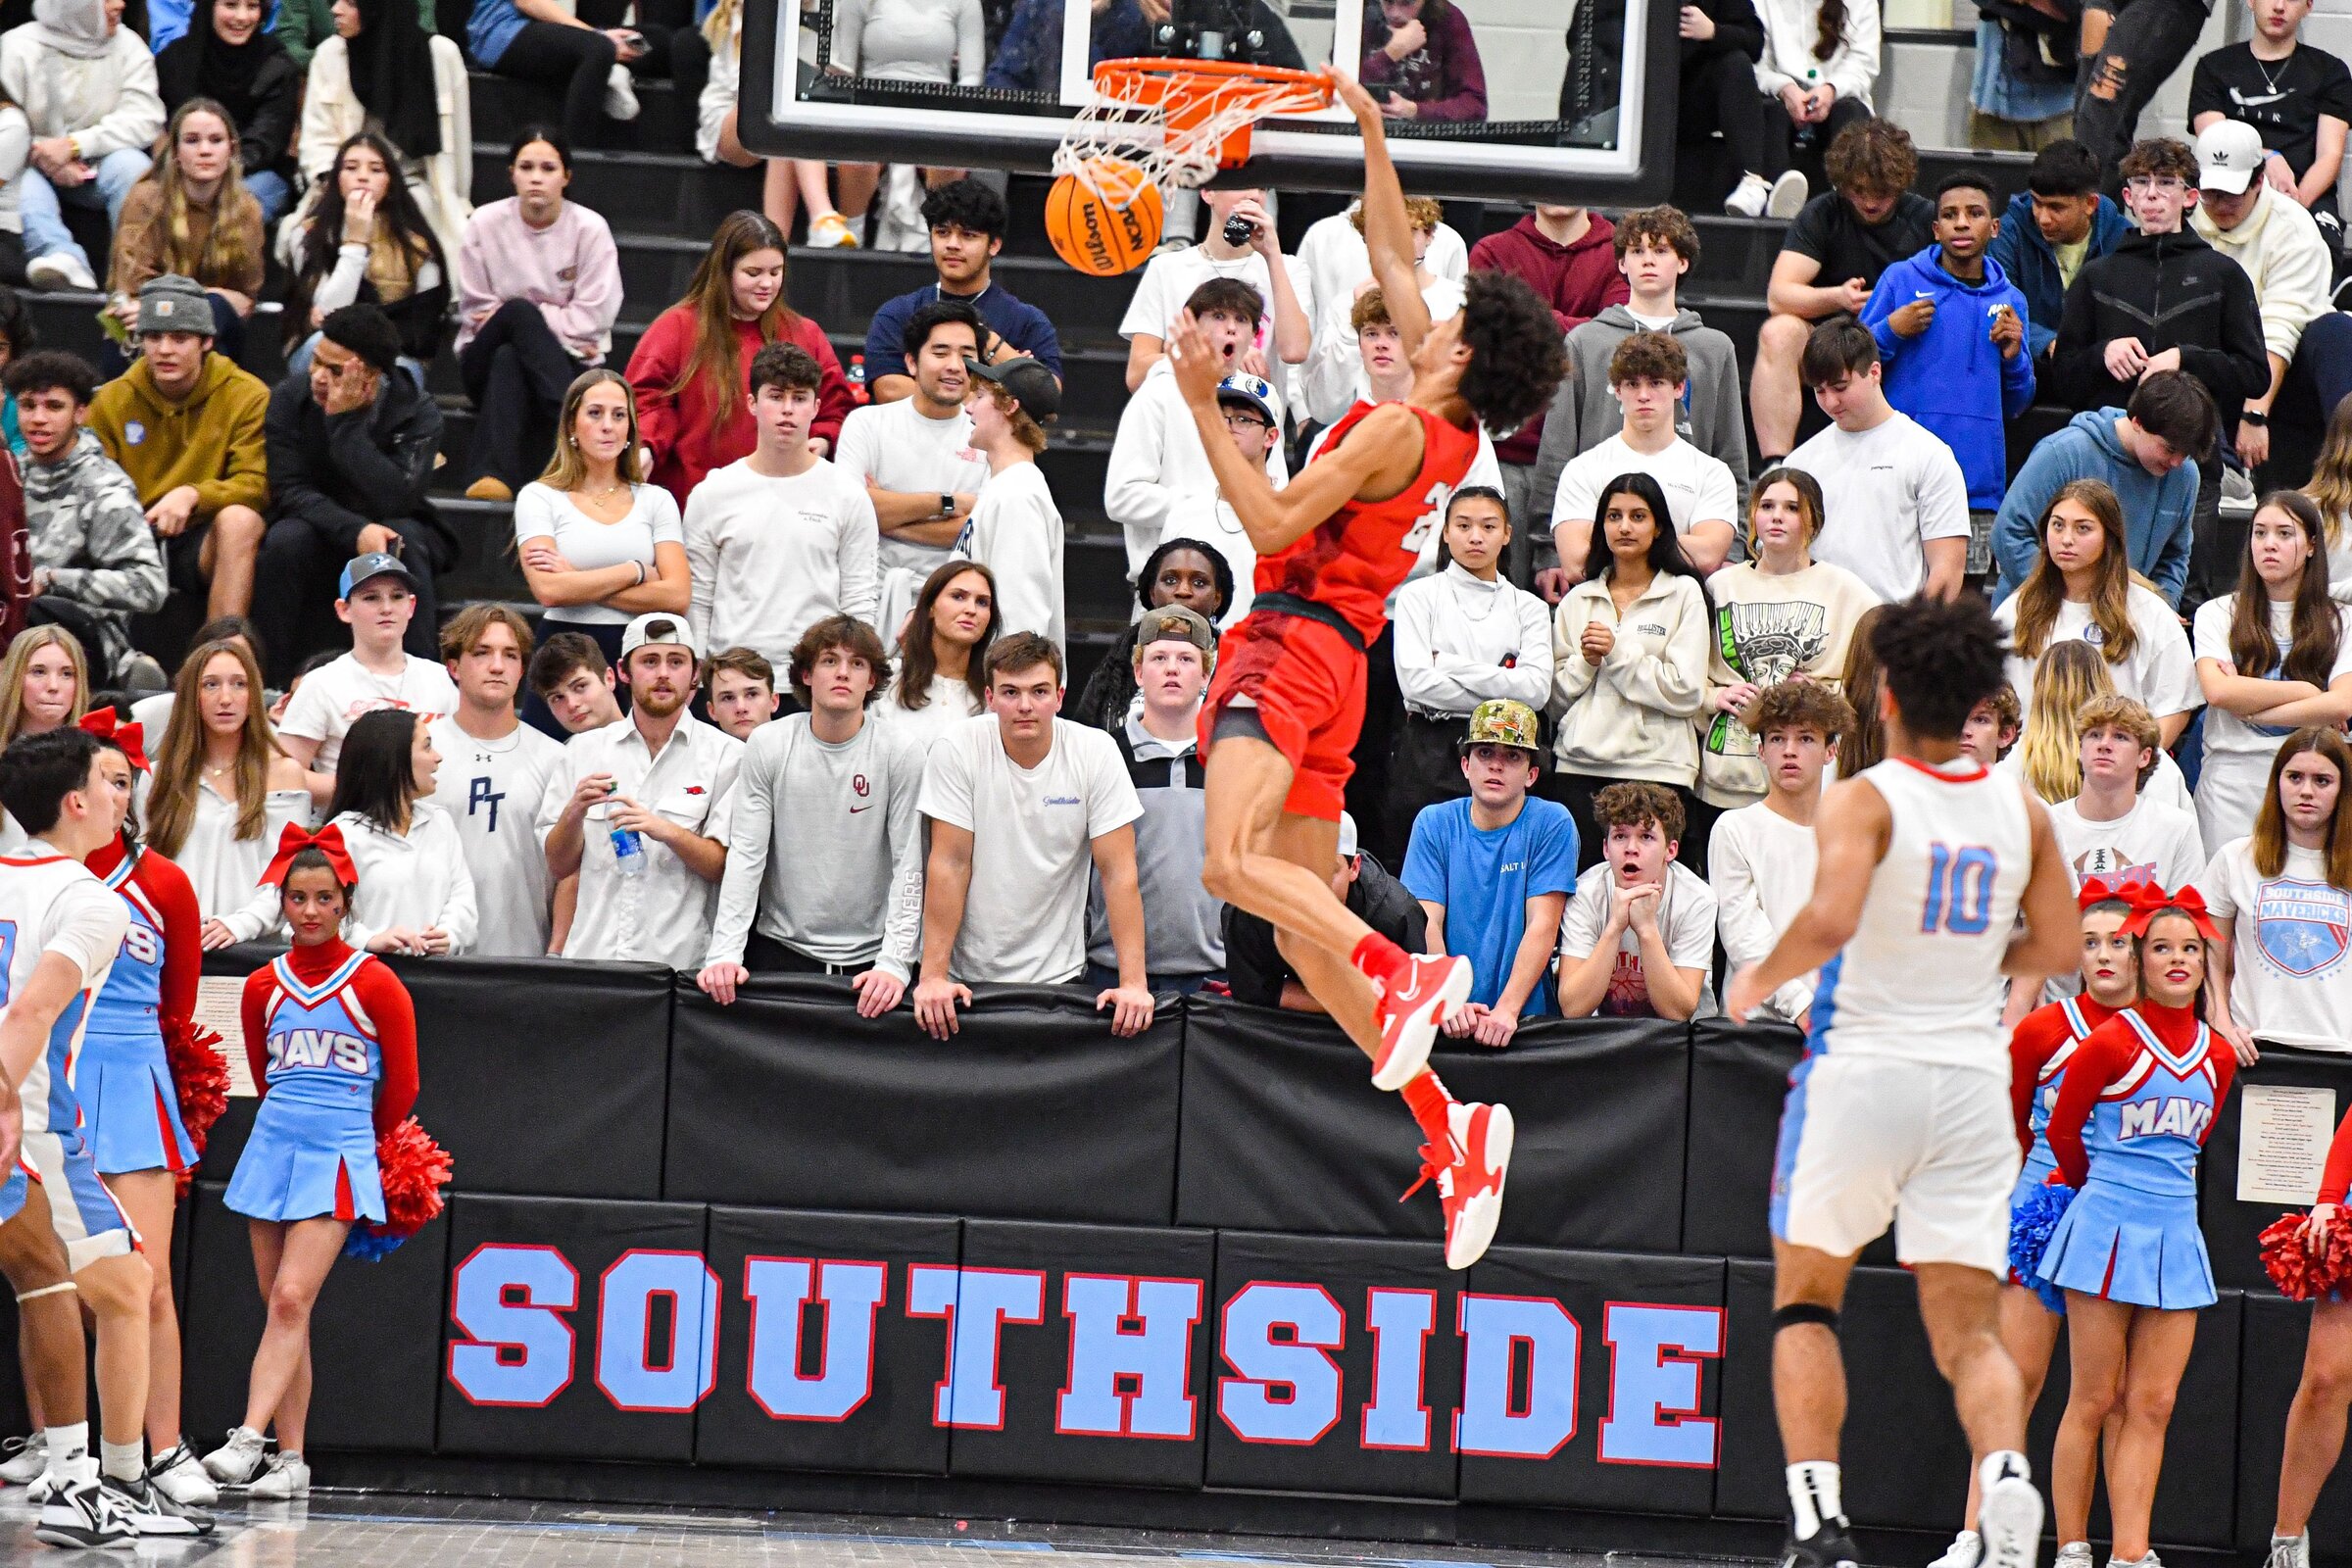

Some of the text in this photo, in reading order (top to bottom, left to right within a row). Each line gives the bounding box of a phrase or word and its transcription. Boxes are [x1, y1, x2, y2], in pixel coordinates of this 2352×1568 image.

[2236, 105, 2282, 123] AIR
[1083, 201, 1114, 270] Wilson
[853, 773, 870, 798] OU
[468, 776, 506, 833] PT
[1499, 861, 1519, 873] SALT
[1922, 840, 1998, 935] 10
[2264, 887, 2344, 906] SOUTHSIDE
[2261, 902, 2347, 924] MAVERICKS
[447, 1242, 1729, 1470] SOUTHSIDE
